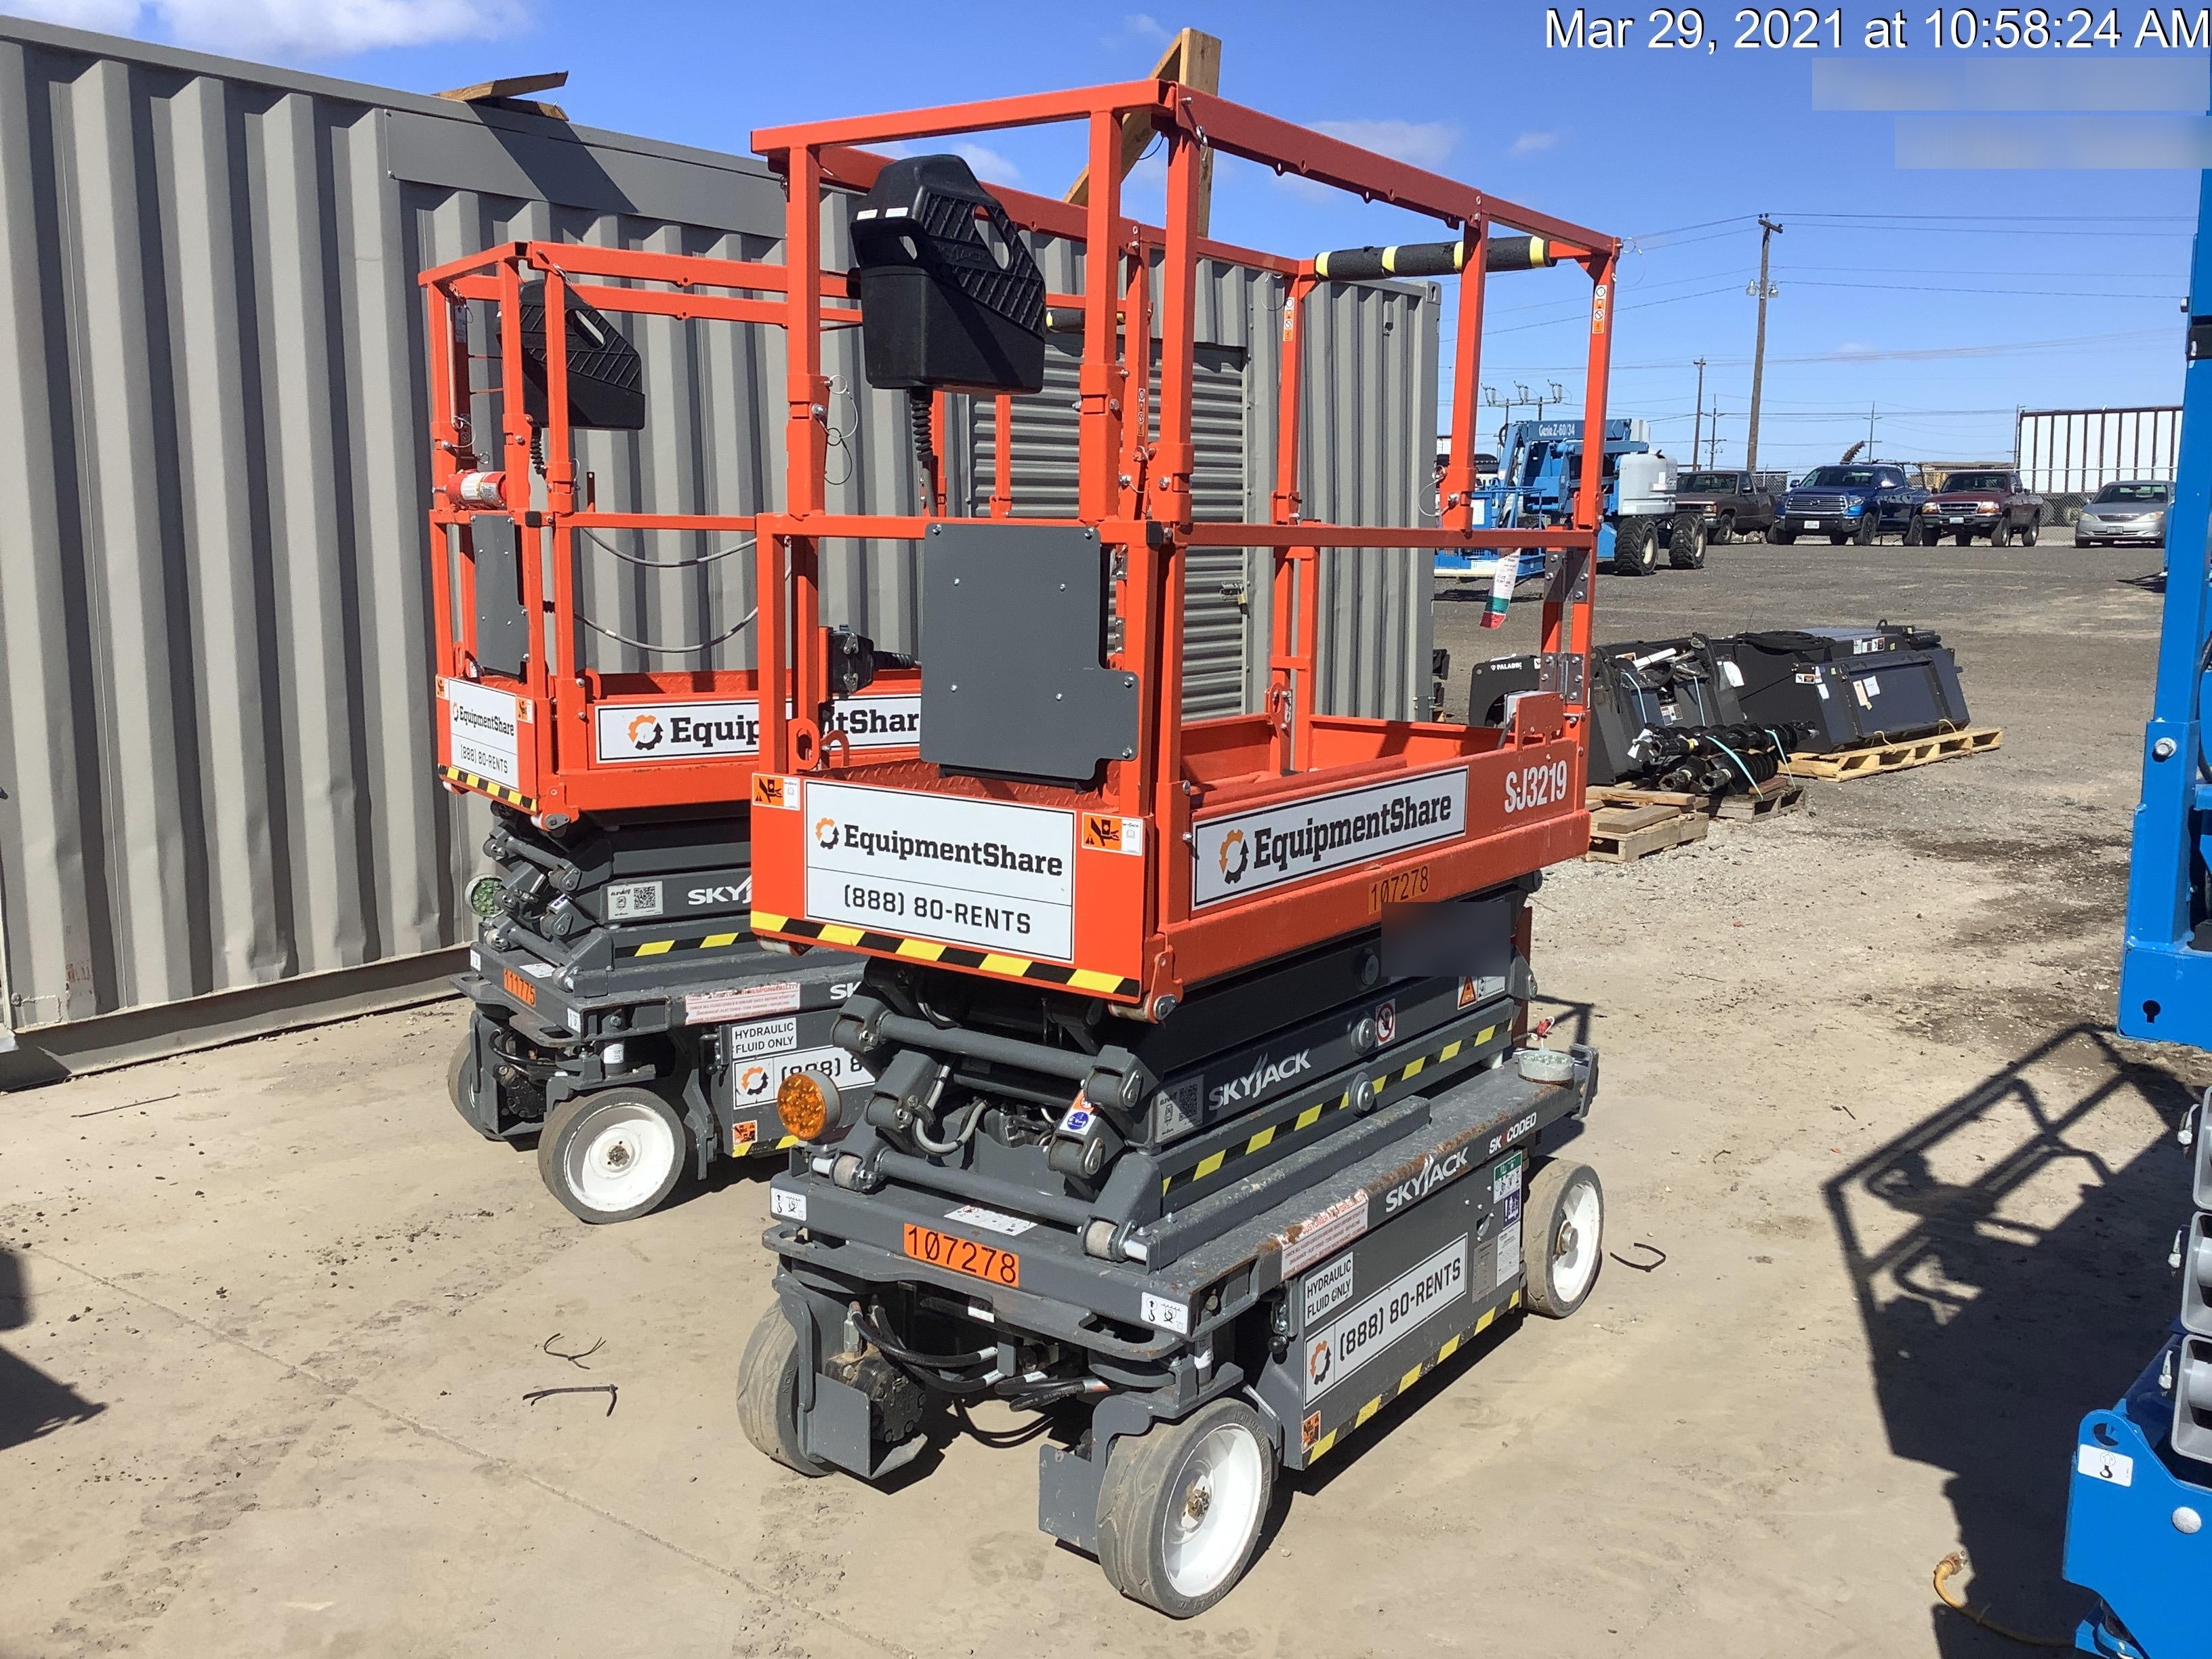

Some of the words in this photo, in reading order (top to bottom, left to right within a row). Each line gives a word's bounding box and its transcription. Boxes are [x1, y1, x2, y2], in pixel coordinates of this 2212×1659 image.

[459, 705, 514, 736] EquipmentShare
[461, 744, 476, 764] (888)
[478, 751, 508, 774] 80-RENTS
[1504, 760, 1568, 813] SJ3219
[844, 824, 1063, 876] EquipmentShare
[1254, 795, 1452, 872] EquipmentShare
[688, 874, 752, 905] SKYJ
[844, 884, 905, 916] (888)
[915, 896, 1031, 935] 80-RENTS
[1371, 865, 1429, 911] 107278
[505, 969, 535, 1005] 111775
[735, 1022, 794, 1040] HYDRAULIC
[736, 1042, 765, 1053] FLUID
[768, 1036, 794, 1048] ONLY
[1209, 1048, 1311, 1111] SKYJACK
[1489, 1112, 1537, 1154] SKCODED
[1386, 1147, 1468, 1212] SKYJACK
[909, 1227, 1016, 1284] 107278
[1307, 1259, 1351, 1298] HYDRAULIC
[1307, 1294, 1330, 1319] FLUID
[1332, 1278, 1351, 1302] ONLY
[1340, 1307, 1384, 1361] (888)
[1390, 1256, 1461, 1324] 80-RENTS
